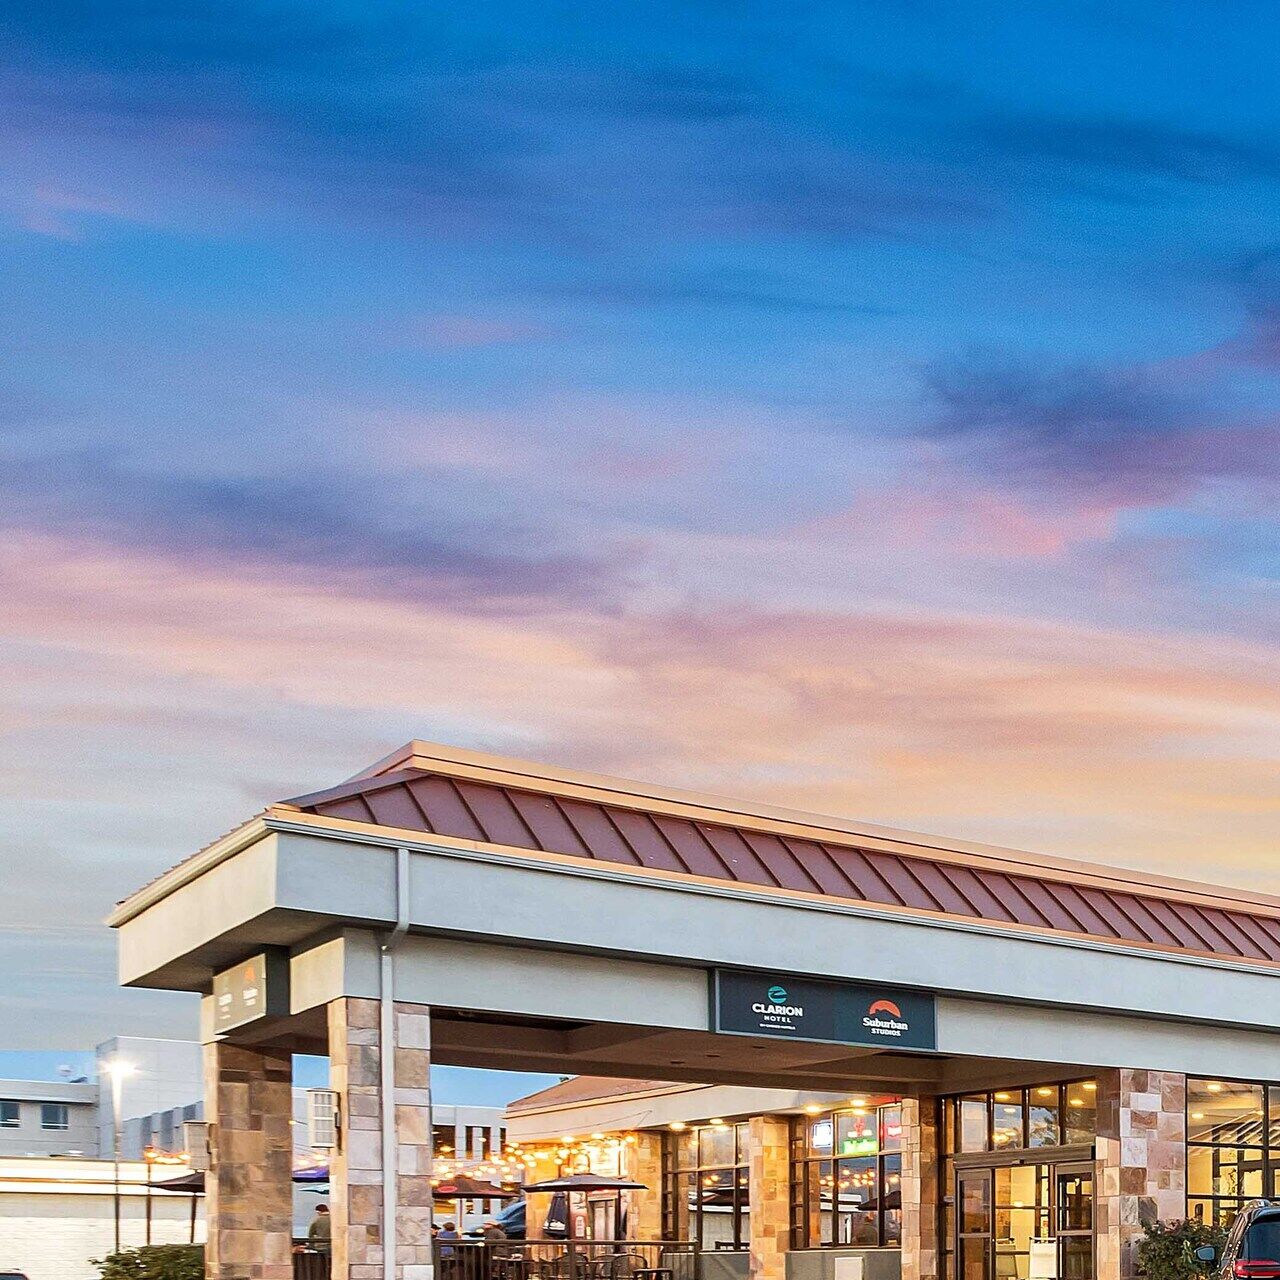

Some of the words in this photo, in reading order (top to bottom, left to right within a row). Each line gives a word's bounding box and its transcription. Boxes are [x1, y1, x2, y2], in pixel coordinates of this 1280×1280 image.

[752, 1003, 803, 1016] CLARION
[763, 1015, 792, 1023] HOTEL
[862, 1017, 908, 1030] Suburban
[871, 1028, 901, 1036] STUDIOS
